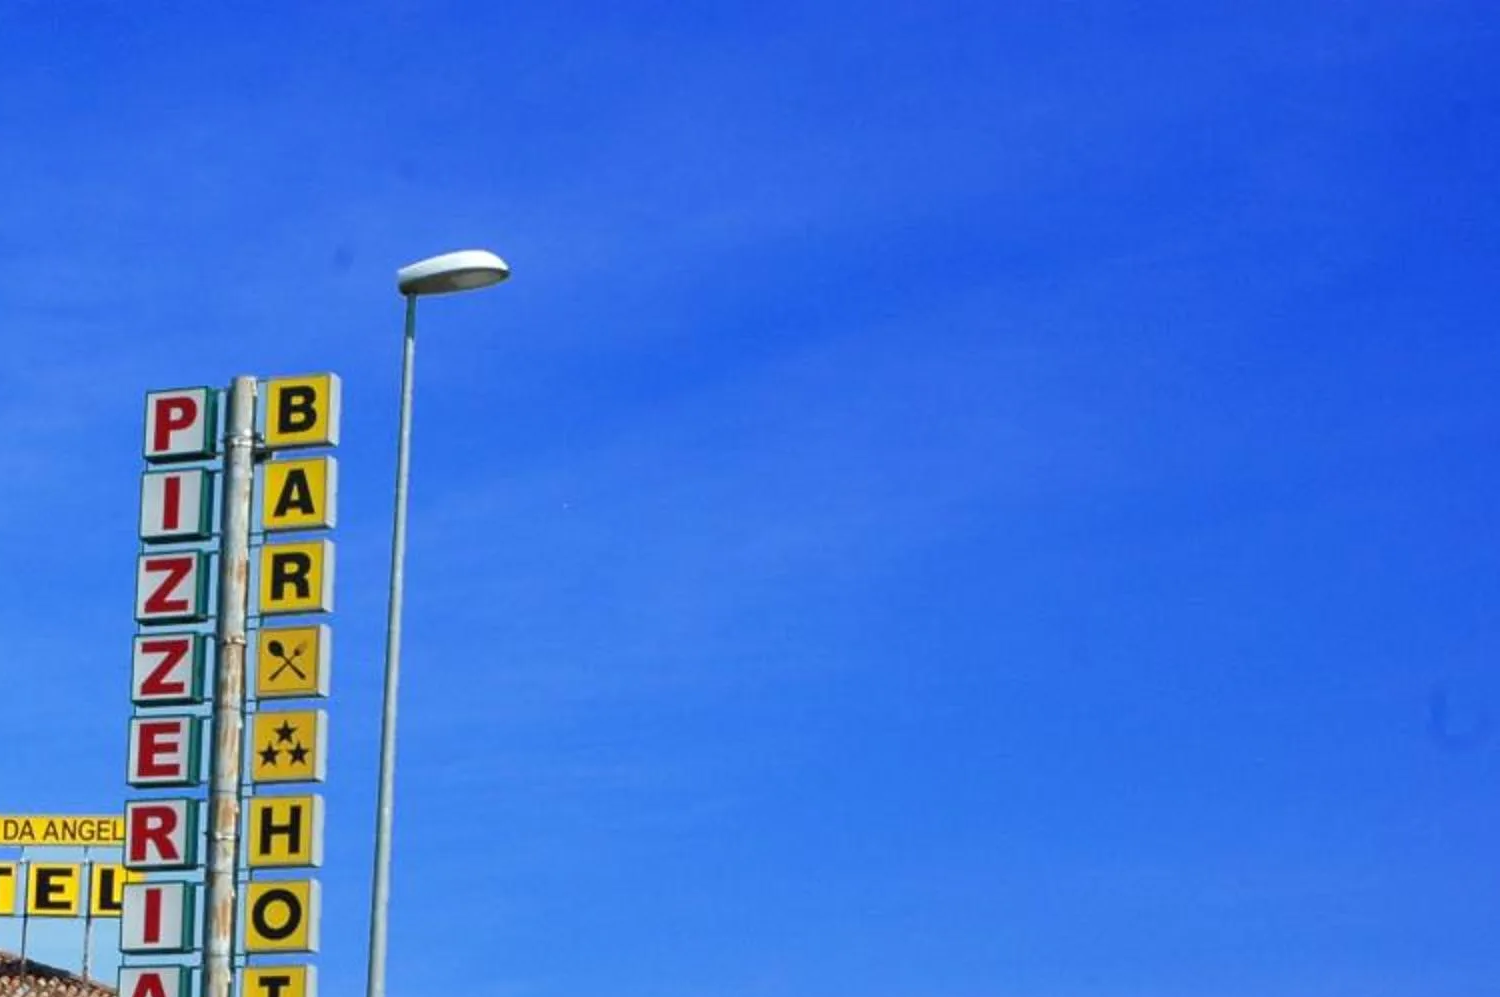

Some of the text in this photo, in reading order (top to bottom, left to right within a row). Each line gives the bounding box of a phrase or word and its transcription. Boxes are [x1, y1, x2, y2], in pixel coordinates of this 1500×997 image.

[271, 384, 318, 600] BAR
[3, 818, 124, 841] DA ANGEL
